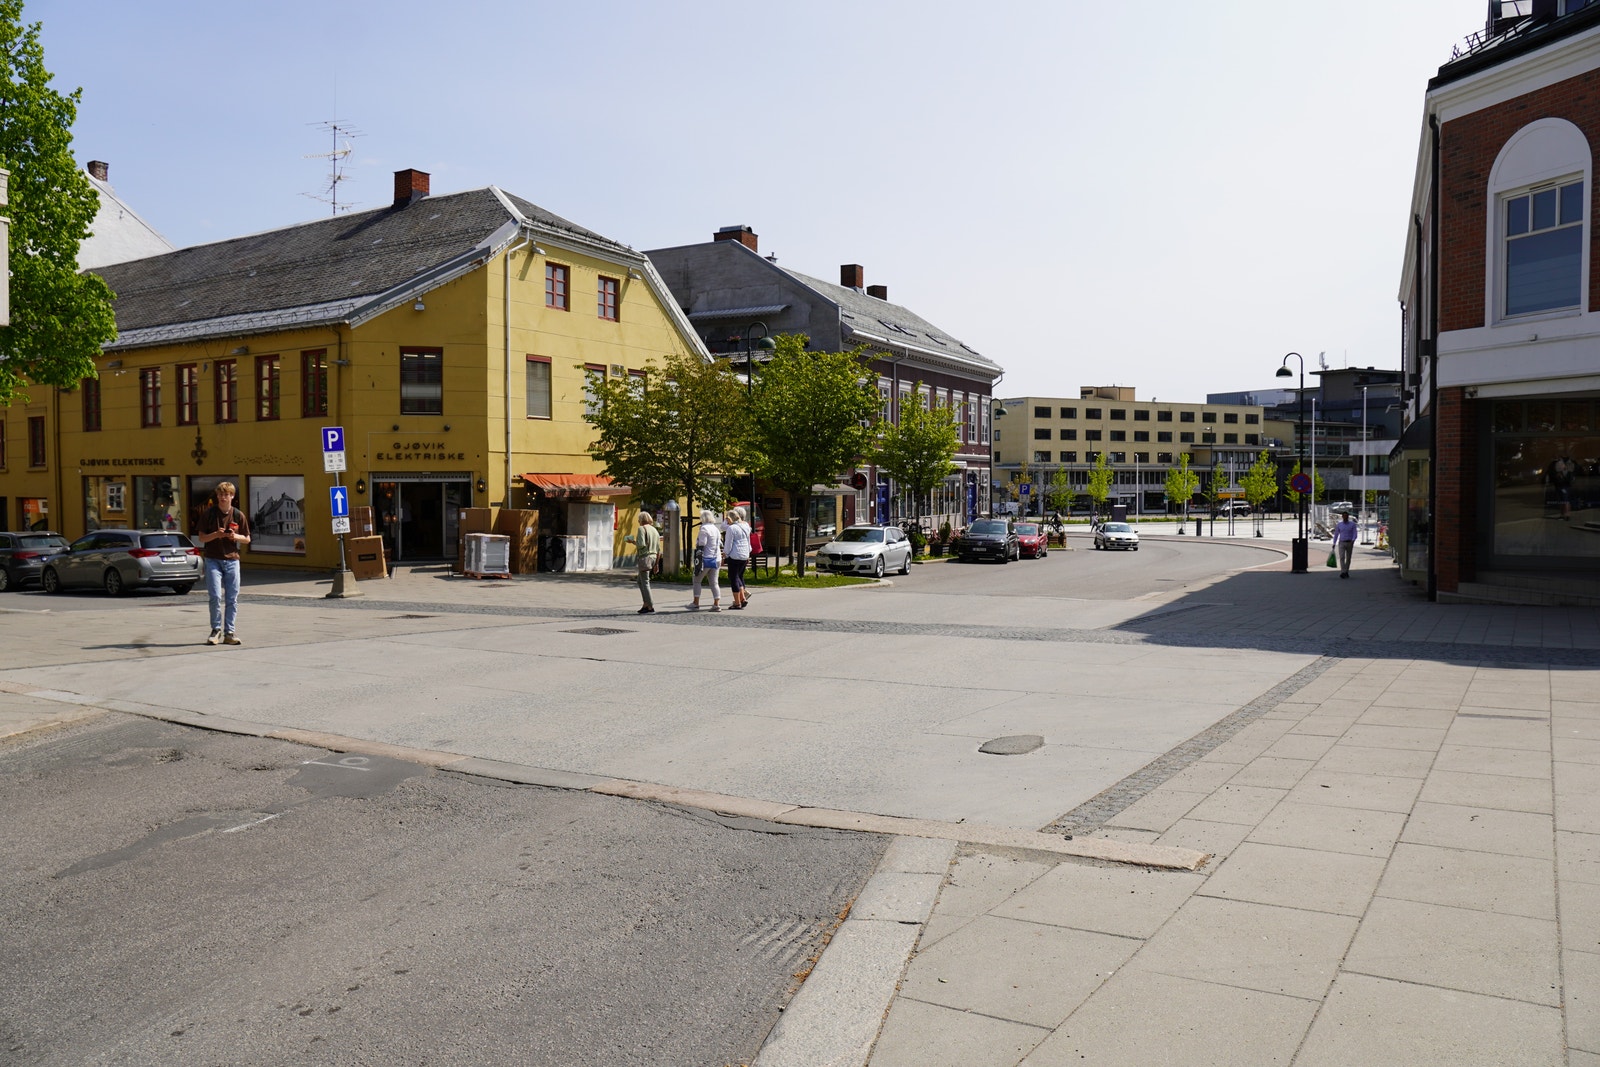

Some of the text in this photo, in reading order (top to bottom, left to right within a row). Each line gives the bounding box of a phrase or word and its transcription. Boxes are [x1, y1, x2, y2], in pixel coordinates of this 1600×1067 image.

[327, 430, 339, 449] P
[393, 442, 445, 450] GJØVIK
[377, 452, 465, 460] ELEKTRISKE
[80, 457, 165, 466] GJØVIK ELEKTRISKE
[1022, 484, 1028, 493] P
